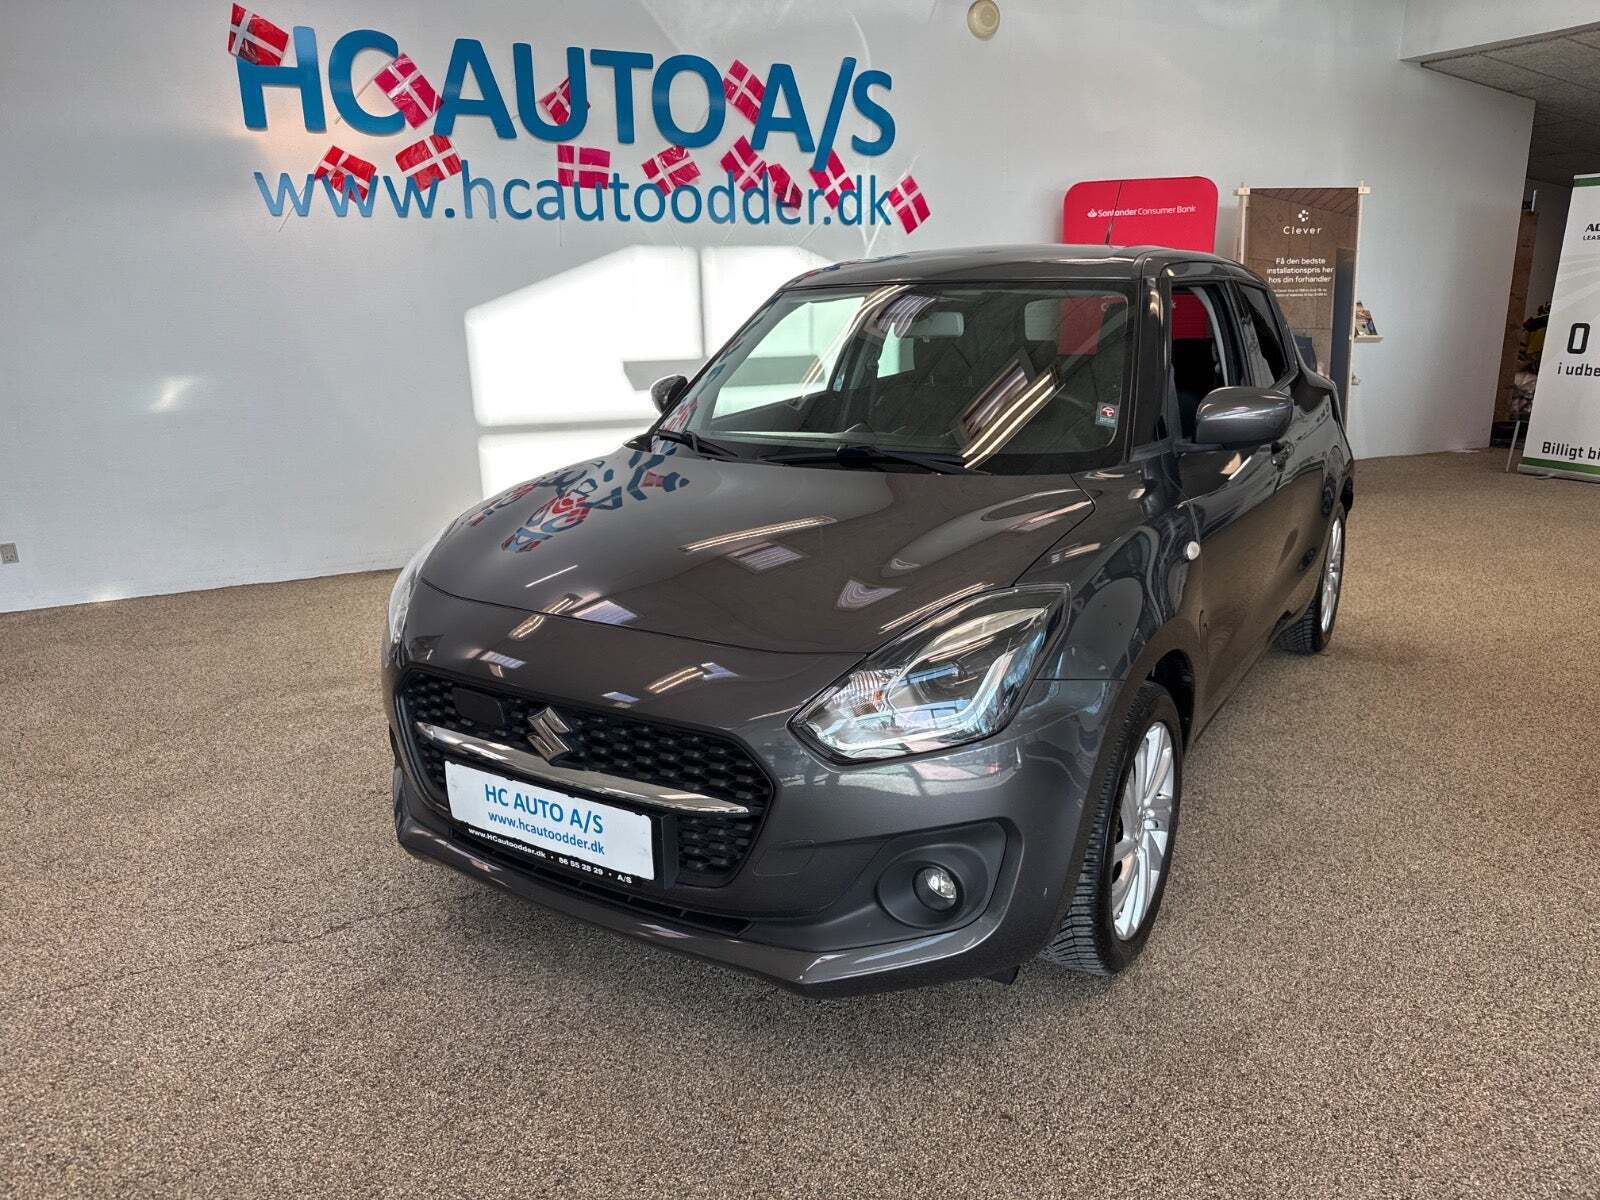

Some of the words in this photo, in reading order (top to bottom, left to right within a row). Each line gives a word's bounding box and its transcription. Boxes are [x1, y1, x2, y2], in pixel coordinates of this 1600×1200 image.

[236, 26, 406, 136] HC
[433, 38, 727, 148] AUTO
[752, 56, 897, 172] A/S
[253, 159, 892, 226] www.hcautoodder.dk
[1097, 208, 1137, 217] Santander
[1137, 206, 1176, 215] Consumer
[1176, 204, 1197, 213] Bank
[1283, 225, 1322, 235] Clever
[1275, 256, 1285, 265] Få
[1286, 257, 1300, 265] den
[1301, 257, 1326, 265] bedste
[1266, 266, 1321, 275] installationspris
[1283, 275, 1294, 283] din
[1295, 275, 1332, 283] forhandler
[1557, 361, 1562, 375] i
[1542, 441, 1584, 460] Billigt
[484, 783, 509, 807] HC
[513, 792, 564, 823] AUTO
[570, 808, 604, 834] A/S
[488, 810, 605, 855] www.hcautoodder.dk
[468, 828, 546, 858] www.HCautoodder.dk
[617, 874, 632, 884] A/S
